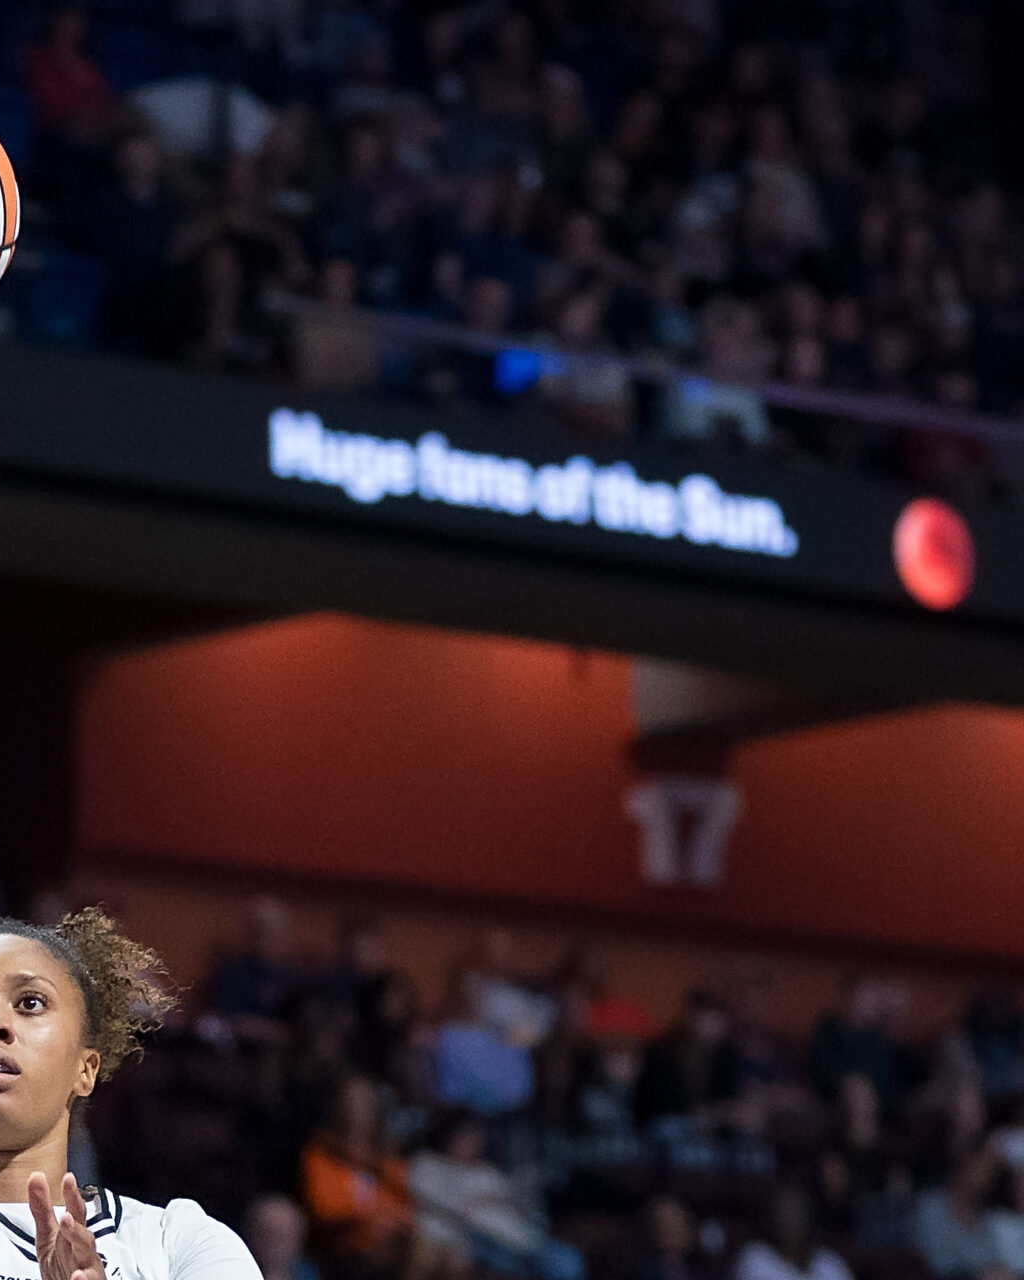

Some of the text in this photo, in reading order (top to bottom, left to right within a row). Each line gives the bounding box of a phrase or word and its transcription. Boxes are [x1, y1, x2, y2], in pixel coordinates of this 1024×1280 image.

[269, 408, 798, 558] Huge fans of the Sun.
